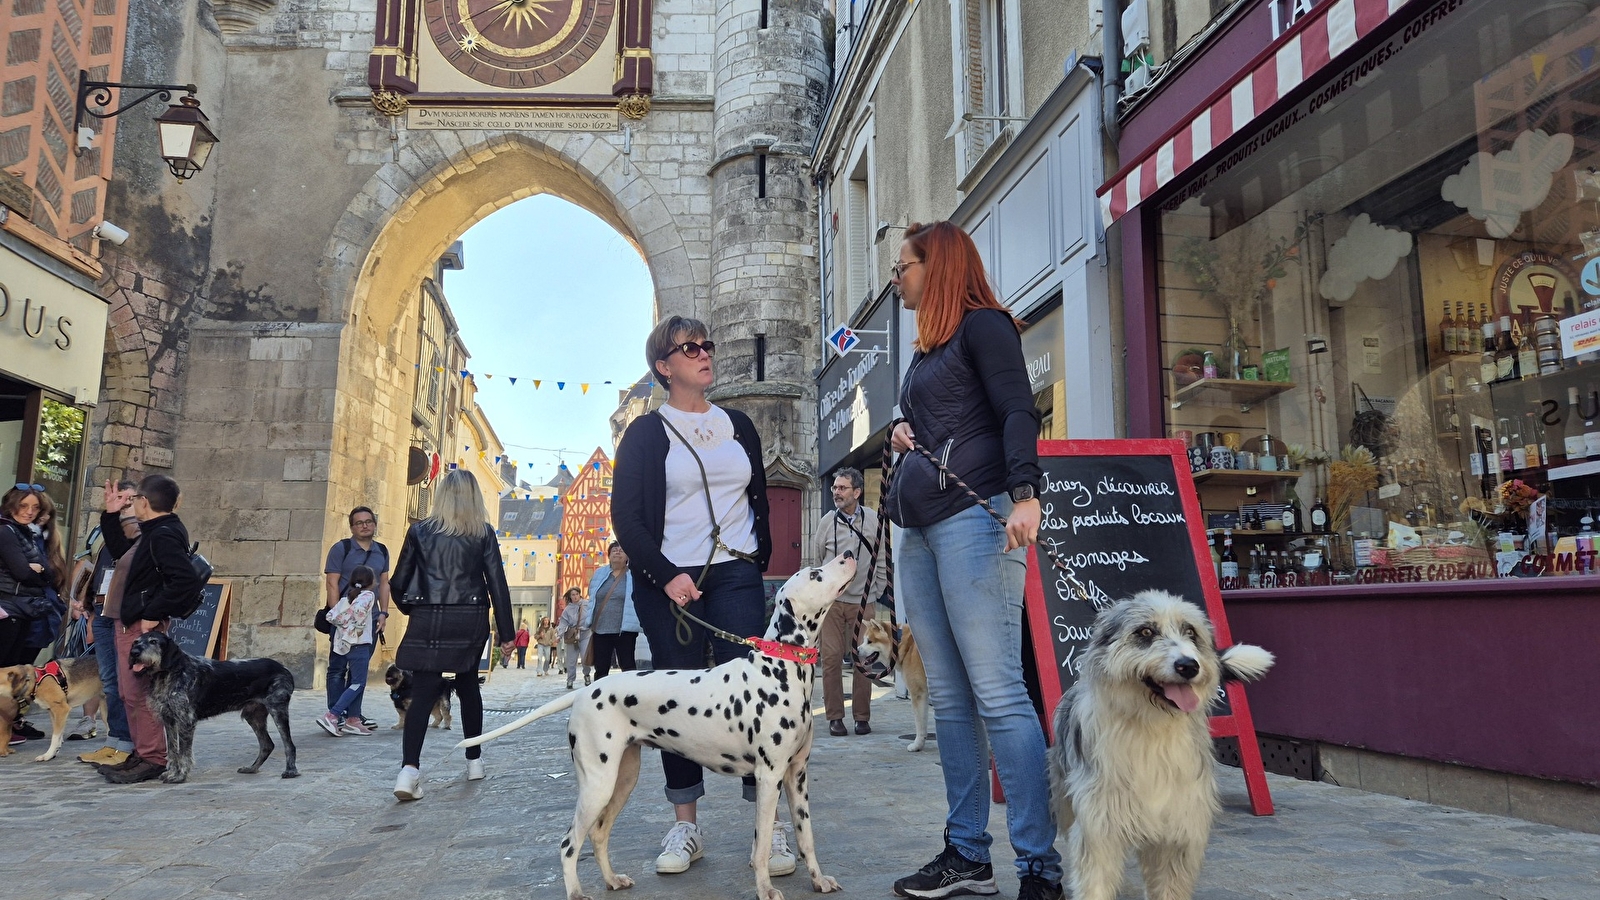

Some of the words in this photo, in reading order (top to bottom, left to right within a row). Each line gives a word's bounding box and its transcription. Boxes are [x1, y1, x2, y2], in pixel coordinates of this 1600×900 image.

[1188, 174, 1208, 197] VRAC
[1500, 267, 1514, 294] JUSTE
[1513, 258, 1524, 269] CE
[1570, 318, 1597, 331] relais
[1072, 506, 1129, 535] produits
[1132, 504, 1186, 524] locaux
[1356, 565, 1422, 585] COFFRETS
